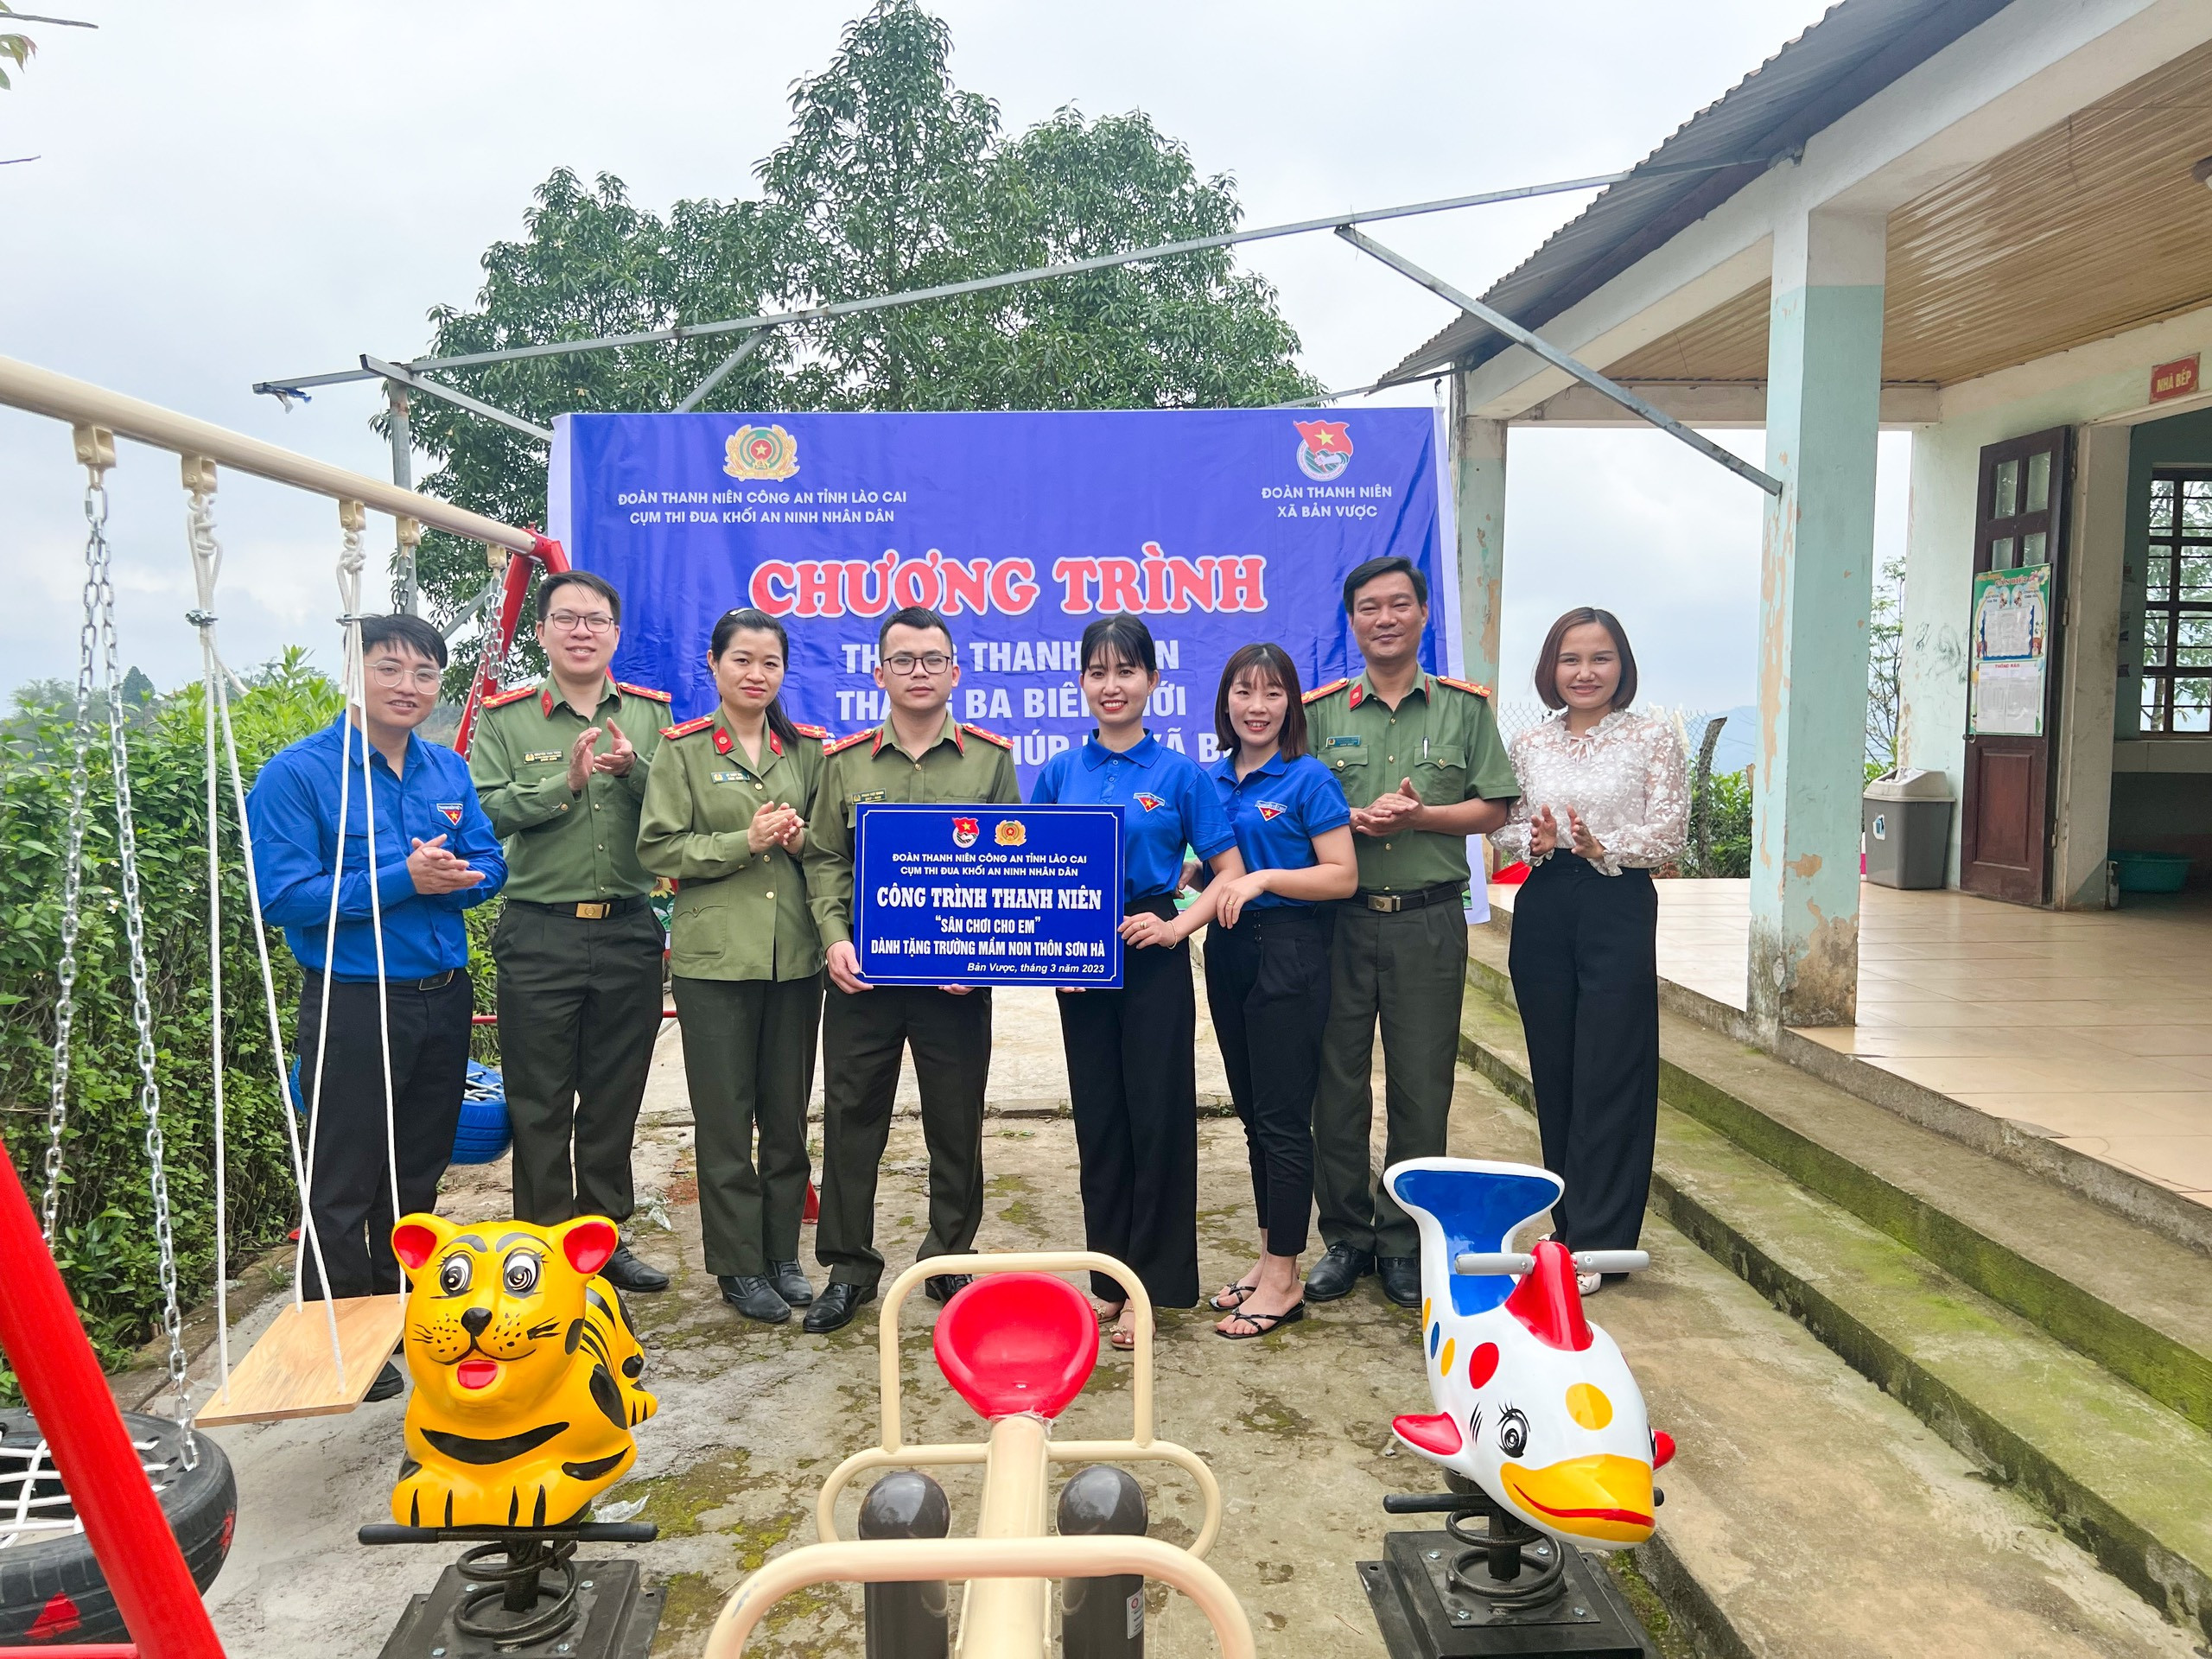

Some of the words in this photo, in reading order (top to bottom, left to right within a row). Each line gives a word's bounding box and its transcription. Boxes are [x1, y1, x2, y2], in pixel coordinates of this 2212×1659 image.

[2157, 373, 2174, 392] NHÀ
[618, 489, 657, 505] ĐOÀN
[661, 492, 708, 503] THANH
[712, 489, 742, 504] NIÊN
[746, 489, 790, 503] CÔNG
[793, 492, 812, 503] AN
[817, 487, 847, 503] TỈNH
[851, 488, 878, 503] LÀO
[881, 491, 906, 502] CAI
[1261, 484, 1302, 499] ĐOÀN
[1306, 486, 1355, 498] THANH
[1359, 483, 1391, 498] NIÊN
[630, 511, 660, 525] CỤM
[664, 511, 684, 523] THI
[689, 511, 718, 523] ĐUA
[722, 506, 756, 523] KHỐI
[760, 511, 779, 522] AN
[785, 511, 817, 523] NINH
[822, 508, 861, 522] NHÂN
[865, 507, 893, 522] DÂN
[1277, 504, 1297, 517] XÃ
[1301, 502, 1331, 517] BẢN
[1335, 504, 1377, 520] VƯỢC
[749, 549, 1040, 618] CHƯƠNG
[1053, 541, 1268, 616] TRÌNH
[969, 641, 1084, 672] THANH
[965, 688, 1013, 720] BA
[1013, 728, 1070, 766] IÚP
[1153, 727, 1186, 756] Ã
[892, 851, 919, 861] ĐOÀN
[955, 852, 976, 861] NIÊN
[978, 852, 1007, 862] CÔNG
[1025, 852, 1046, 862] TỈNH
[1048, 853, 1067, 863] LÀO
[1070, 855, 1086, 863] CAI
[900, 866, 921, 876] CỤM
[962, 864, 984, 874] KHỐI
[987, 867, 1001, 875] AN
[1028, 866, 1055, 875] NHÂN
[1058, 866, 1077, 876] DÂN
[876, 882, 925, 907] CÔNG
[931, 883, 987, 907] TRÌNH
[991, 887, 1052, 908] THANH
[1058, 884, 1101, 909] NIÊN
[965, 918, 990, 932] CHƠI
[994, 918, 1014, 933] CHO
[871, 937, 899, 953] DÀNH
[902, 937, 930, 957] TẶNG
[933, 937, 975, 955] TRƯỜNG
[1008, 941, 1031, 955] NON
[1033, 938, 1062, 956] THÔN
[1065, 940, 1087, 956] SƠN
[1090, 939, 1104, 957] HÀ
[967, 962, 986, 970] Bản
[989, 963, 1016, 973] Vược,
[1020, 963, 1047, 974] tháng
[1050, 963, 1056, 972] 3
[1058, 963, 1078, 972] năm
[1081, 963, 1103, 973] 2023
